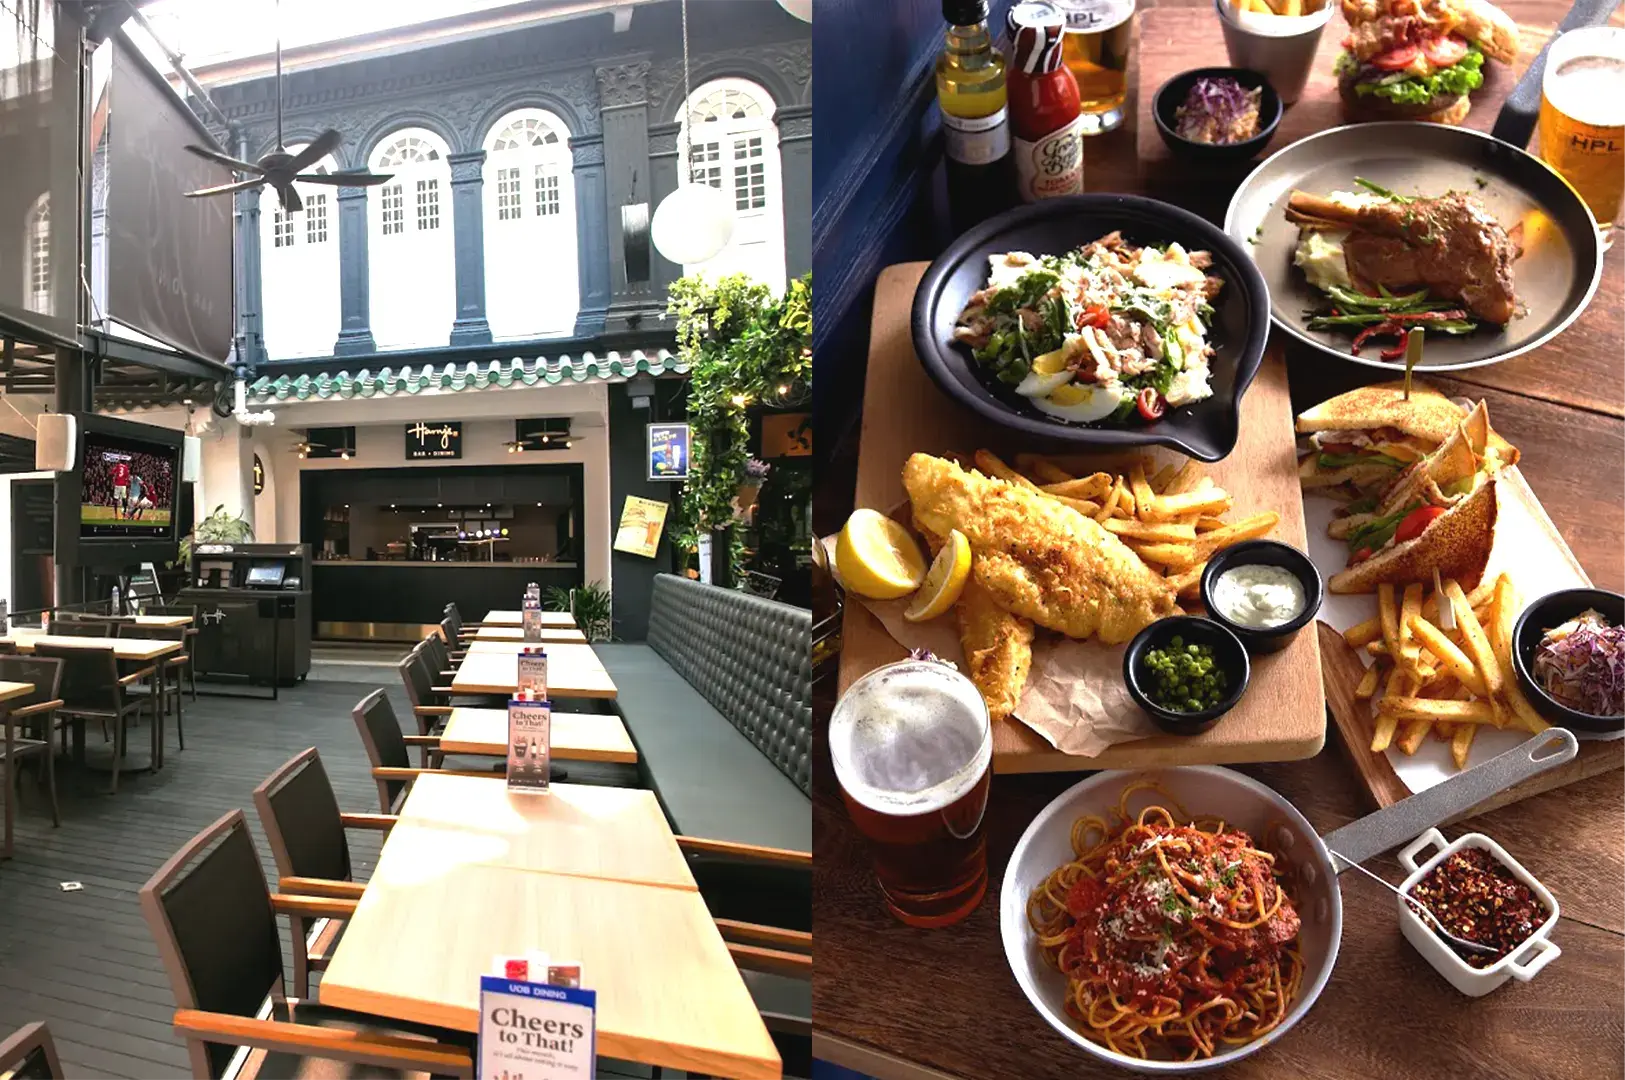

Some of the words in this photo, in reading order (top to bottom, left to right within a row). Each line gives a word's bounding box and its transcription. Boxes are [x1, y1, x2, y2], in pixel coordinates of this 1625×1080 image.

[1571, 135, 1622, 152] HPL
[512, 711, 547, 721] Cheers
[509, 984, 530, 994] UOB
[533, 987, 567, 1000] DINING
[491, 1007, 584, 1039] Cheers
[499, 1030, 517, 1044] to
[521, 1032, 573, 1053] That!
